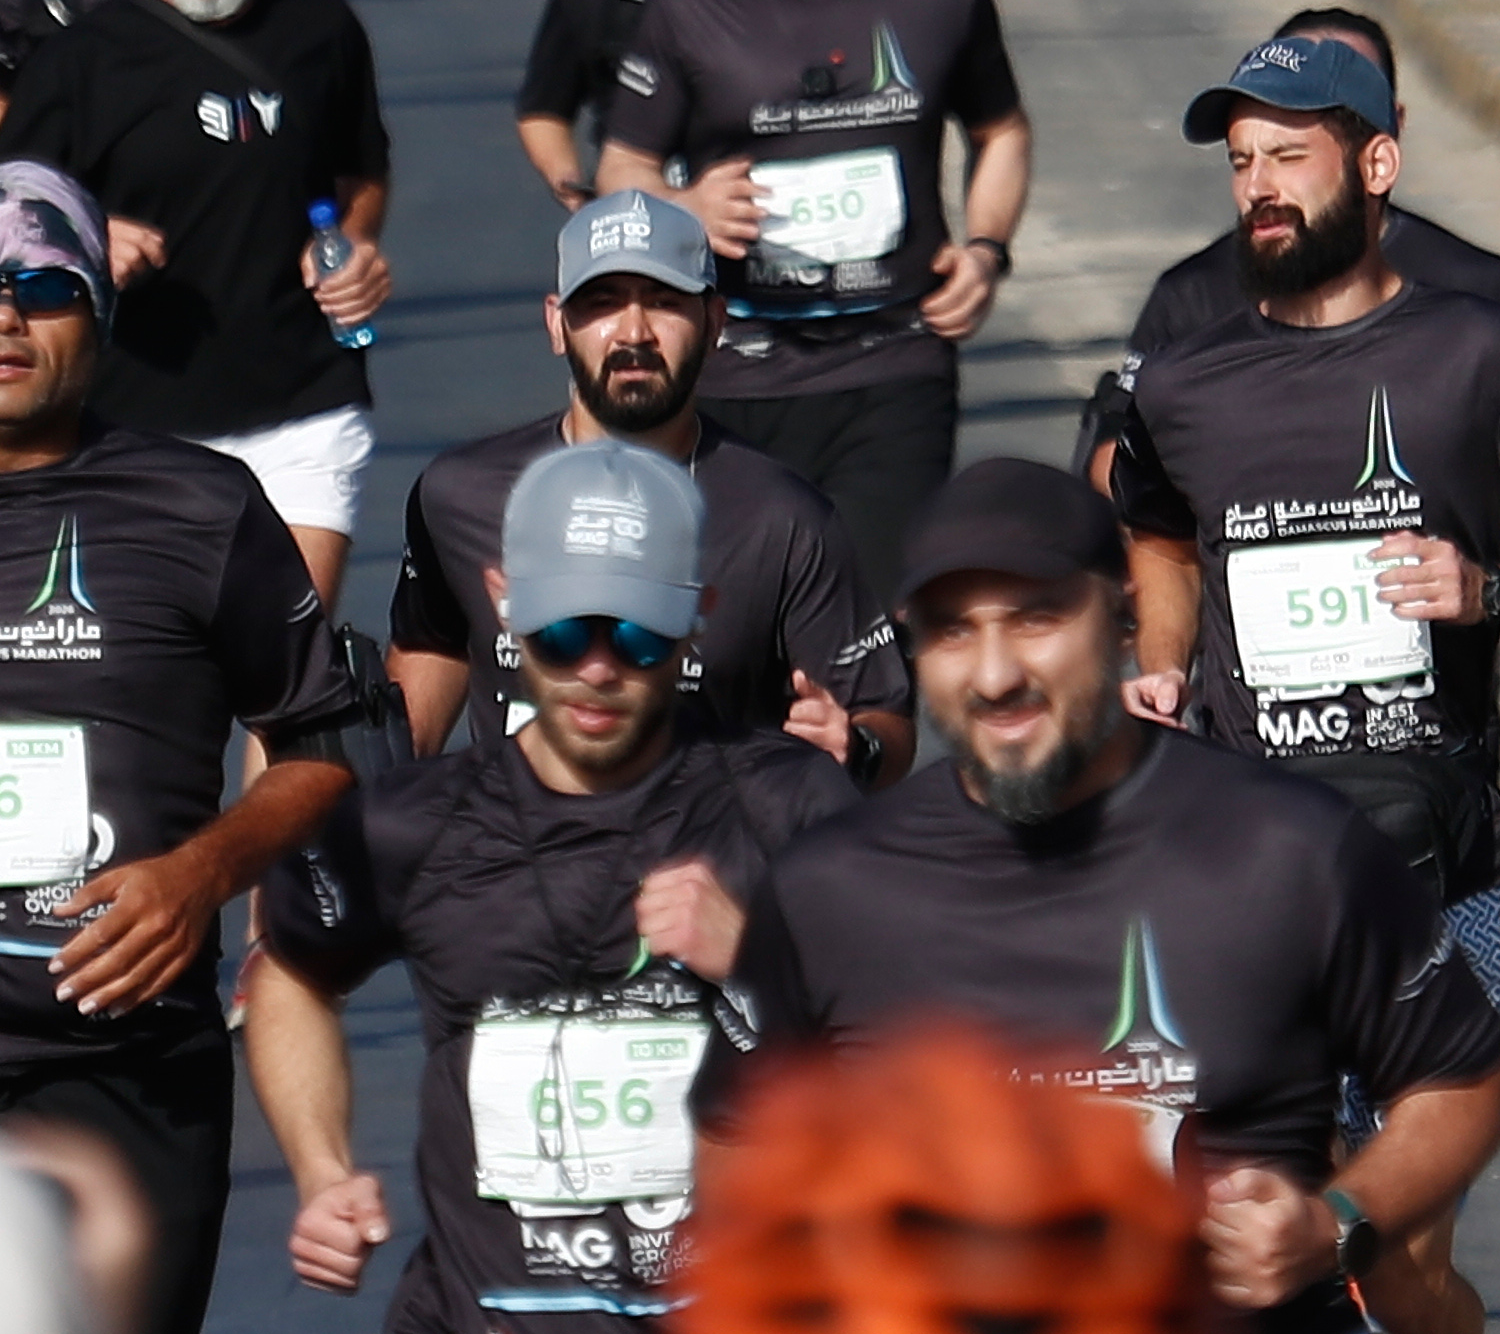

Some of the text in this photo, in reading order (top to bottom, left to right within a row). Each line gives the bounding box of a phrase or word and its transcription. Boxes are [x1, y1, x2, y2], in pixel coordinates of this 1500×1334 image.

[790, 189, 865, 225] 650
[1225, 515, 1423, 541] MAG DAMASCUS MARATHON
[1286, 583, 1371, 629] 591
[12, 647, 103, 661] MARATHON
[1257, 704, 1351, 746] MAG
[1366, 702, 1415, 723] INEST
[10, 742, 60, 756] 10 KM
[631, 1043, 684, 1058] 10 KM
[529, 1078, 653, 1130] 656
